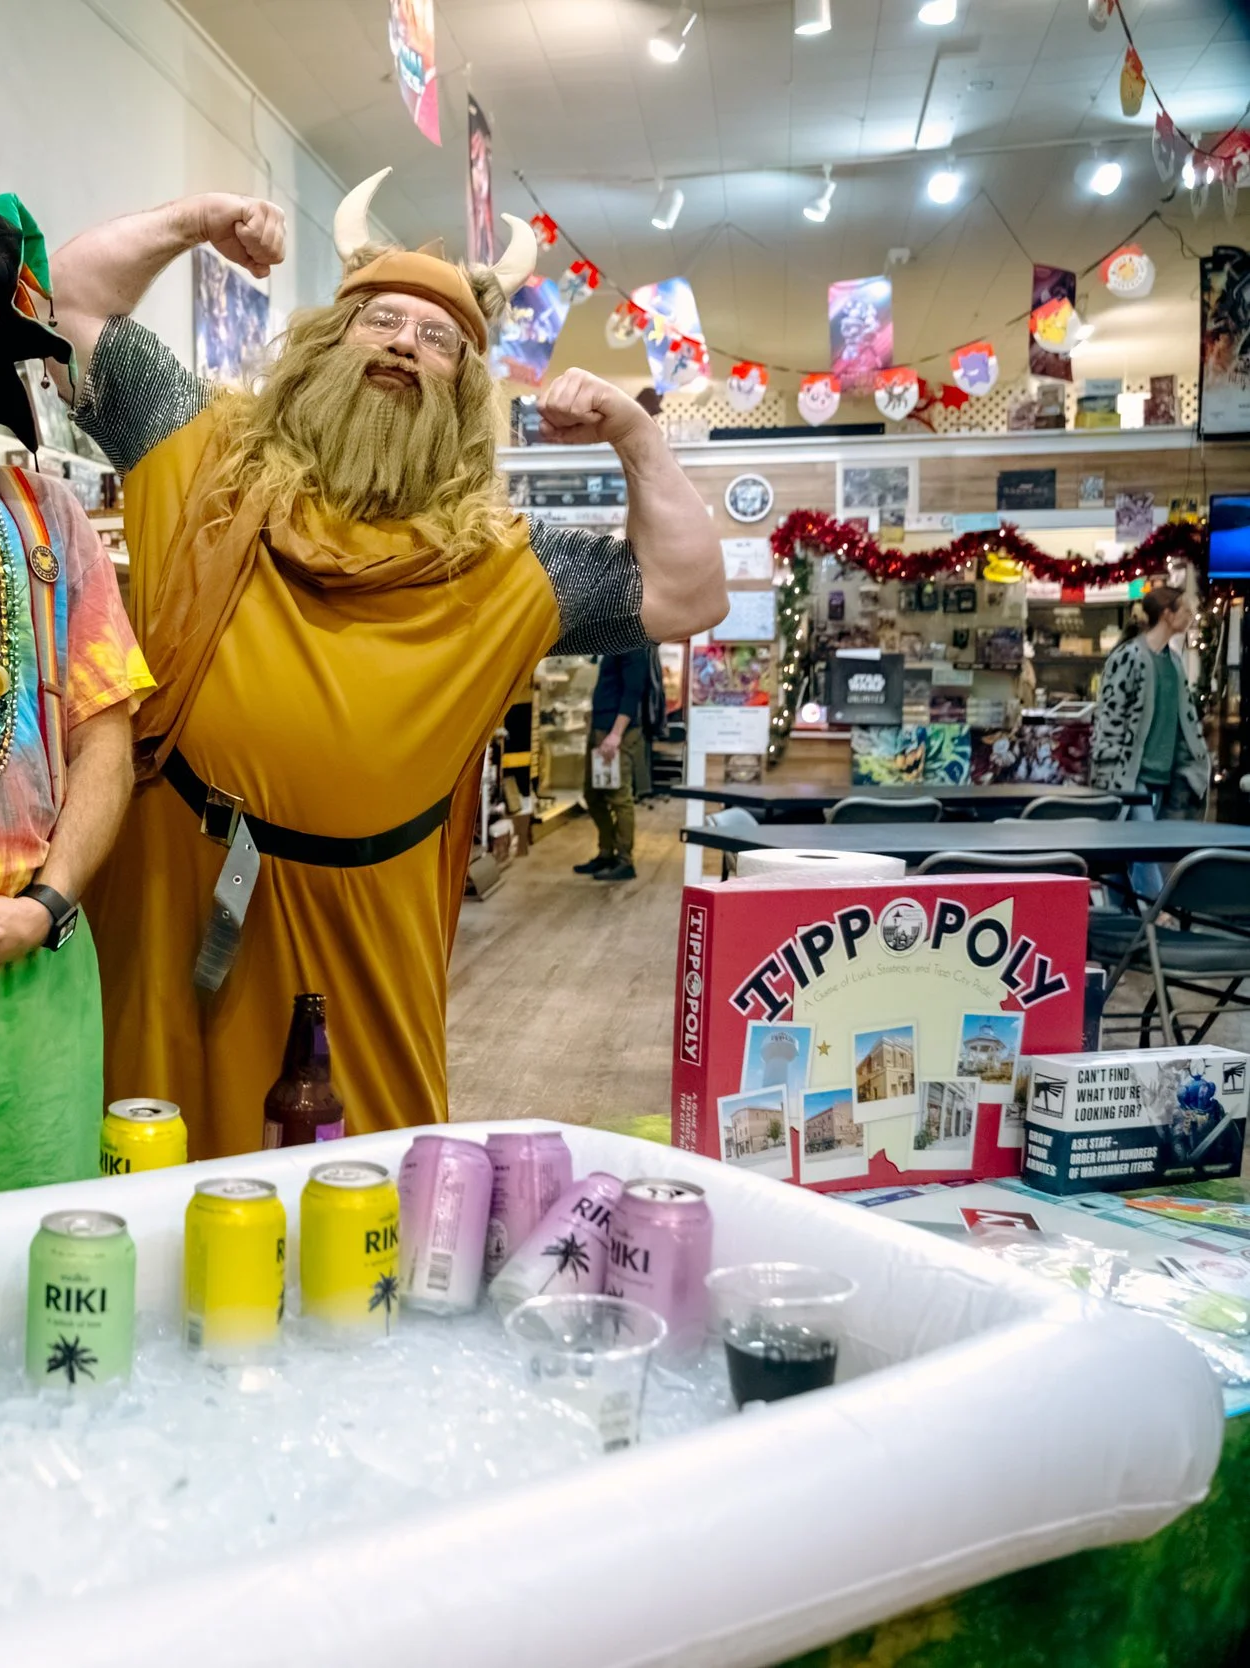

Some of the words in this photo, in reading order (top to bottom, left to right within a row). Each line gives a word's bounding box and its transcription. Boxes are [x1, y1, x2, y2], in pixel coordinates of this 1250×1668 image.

[848, 681, 886, 692] WARS
[852, 673, 884, 682] STAR
[1078, 1069, 1108, 1084] CAN'T
[1109, 1067, 1130, 1082] FIND
[1077, 1087, 1105, 1103] WHAT
[1108, 1085, 1142, 1102] YOU'RE
[1075, 1106, 1115, 1122] LOOKING
[1117, 1103, 1142, 1119] FOR?
[1028, 1129, 1054, 1148] GROW
[1071, 1138, 1089, 1151] ASK
[1028, 1144, 1048, 1160] YOUR
[1069, 1151, 1097, 1165] ORDER
[1096, 1150, 1119, 1163] FROM
[1119, 1146, 1158, 1161] HUNDREDS
[1026, 1157, 1057, 1177] ARMIES
[1068, 1167, 1080, 1180] OF
[1080, 1163, 1129, 1179] WARHAMMER
[1129, 1161, 1155, 1173] ITEMS.
[571, 1197, 611, 1236] RIK
[364, 1220, 399, 1255] RIK
[45, 1282, 107, 1314] RIKI
